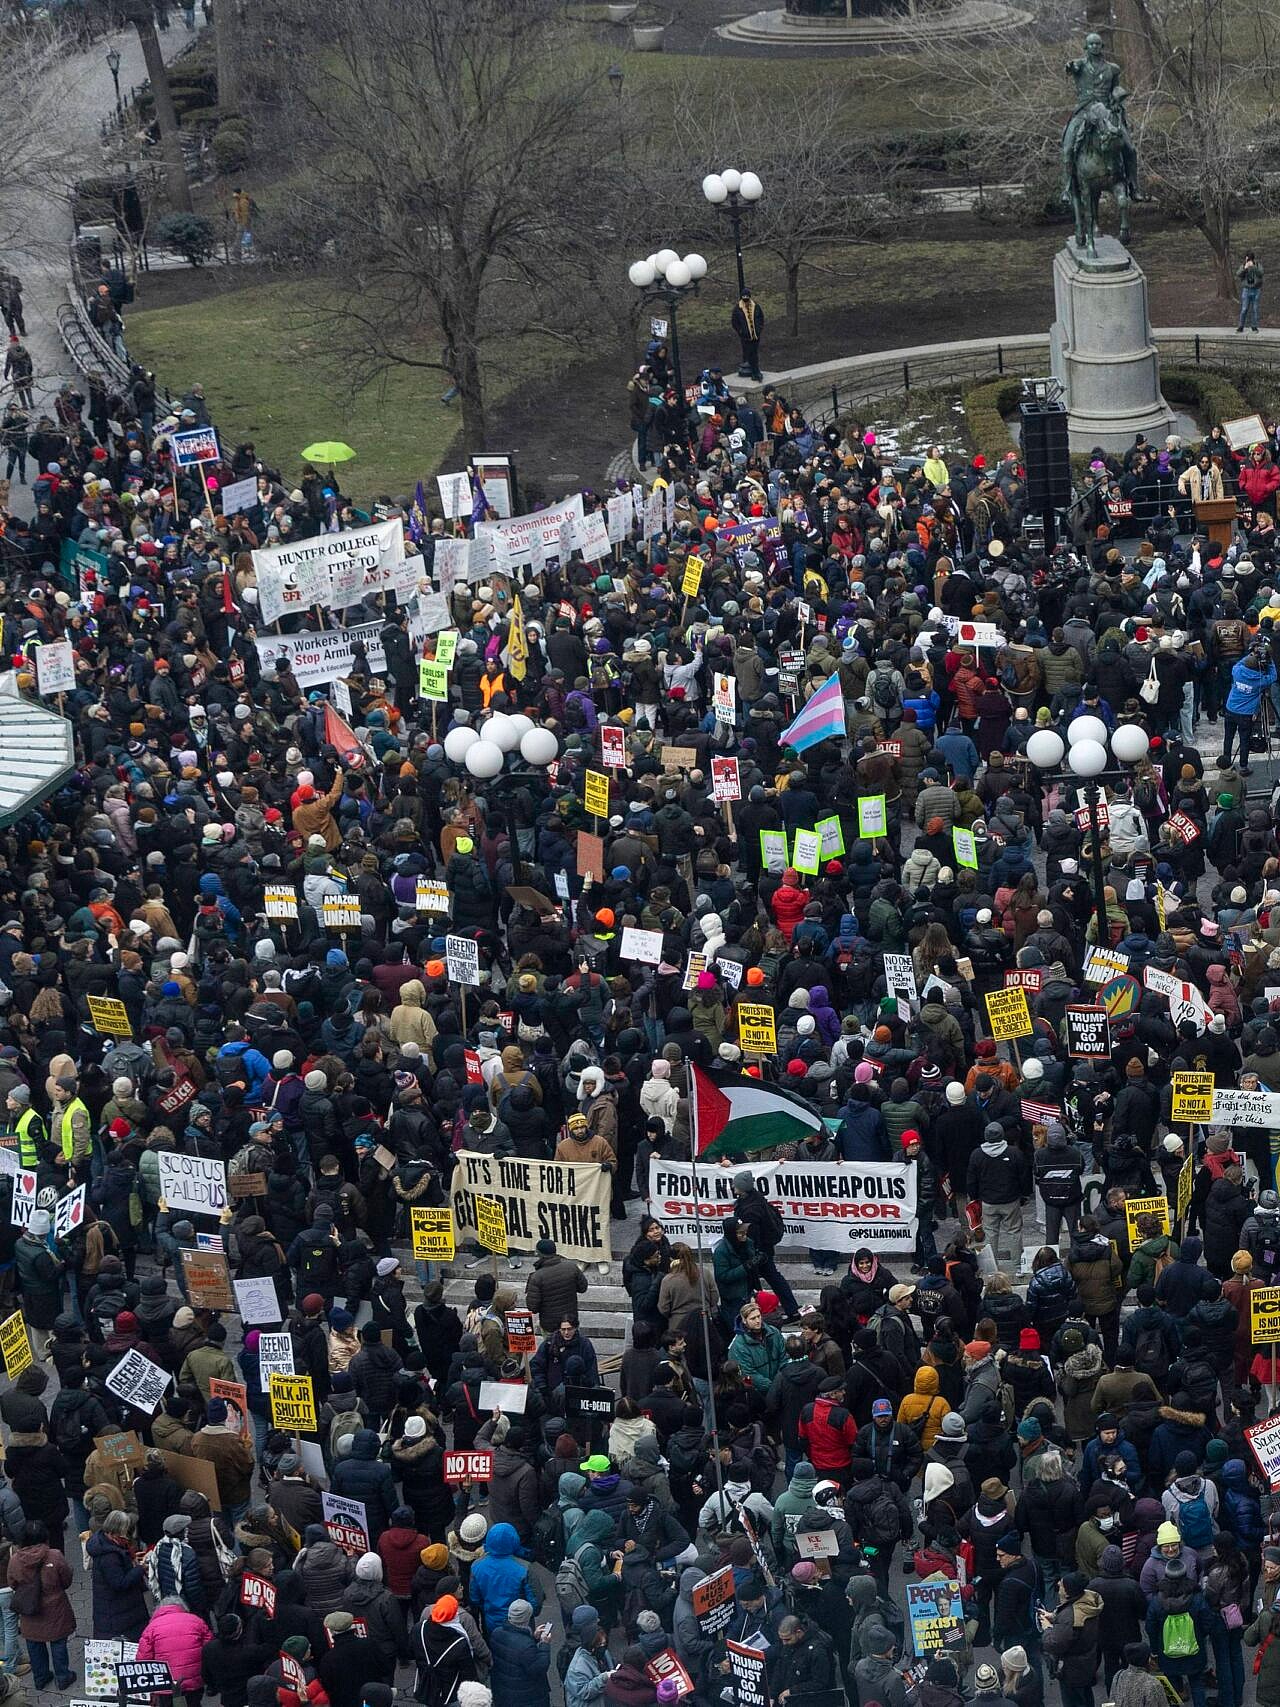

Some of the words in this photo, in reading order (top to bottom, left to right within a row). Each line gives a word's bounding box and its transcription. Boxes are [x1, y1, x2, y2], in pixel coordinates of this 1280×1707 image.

[510, 514, 562, 534] Committee
[564, 511, 576, 521] to
[278, 547, 326, 566] HUNTER
[328, 534, 379, 554] COLLEGE
[358, 555, 375, 567] TO
[977, 632, 994, 640] ICE
[294, 636, 338, 652] Workers
[295, 654, 320, 668] Stop
[422, 668, 444, 679] ABOLISH
[426, 678, 438, 688] ICE!
[886, 744, 900, 754] ICE!
[716, 788, 738, 799] STRIKE
[1079, 810, 1091, 824] NO
[1171, 812, 1185, 828] NO
[1183, 820, 1199, 841] ICE!
[265, 886, 295, 897] AMAZON
[417, 880, 447, 892] AMAZON
[324, 895, 360, 906] AMAZON
[416, 894, 449, 912] UNFAIR
[266, 902, 298, 918] UNFAIR
[325, 910, 362, 926] UNFAIR
[448, 937, 476, 954] DEFEND
[885, 956, 898, 965] NO
[1093, 948, 1129, 966] AMAZON
[1006, 972, 1020, 986] NO
[1021, 972, 1040, 986] ICE!
[987, 988, 1021, 1000] FIGHT
[90, 998, 107, 1007] DROP
[107, 1000, 123, 1010] THE
[740, 1004, 774, 1017] PROTESTING
[1178, 1002, 1196, 1018] NO
[990, 1006, 1001, 1016] AND
[1012, 1012, 1028, 1022] EVILS
[741, 1016, 772, 1028] ICE
[1068, 1012, 1106, 1024] TRUMP
[995, 1026, 1003, 1035] OF
[1072, 1022, 1104, 1032] MUST
[746, 1030, 752, 1039] IS
[752, 1030, 765, 1040] NOT
[764, 1030, 770, 1040] A
[1080, 1032, 1096, 1042] GO
[742, 1038, 775, 1047] CRIME!
[1076, 1042, 1105, 1052] NOW!
[1175, 1073, 1213, 1085] PROTESTING
[160, 1094, 178, 1111] NO
[174, 1080, 193, 1102] ICE!
[1175, 1084, 1211, 1098] ICE
[1215, 1091, 1236, 1100] Dad
[1238, 1092, 1250, 1100] did
[1252, 1094, 1266, 1104] not
[1179, 1100, 1187, 1111] IS
[1188, 1100, 1200, 1111] NOT
[1199, 1100, 1206, 1111] A
[1245, 1114, 1264, 1124] this
[466, 1158, 492, 1185] IT'S
[498, 1160, 531, 1192] TIME
[540, 1165, 564, 1195] FOR
[568, 1168, 577, 1196] A
[16, 1174, 22, 1195] I
[656, 1172, 710, 1199] FROM
[775, 1174, 906, 1200] MINNEAPOLIS
[164, 1178, 210, 1203] FAILED
[208, 1183, 227, 1209] US
[664, 1201, 736, 1218] STOP
[787, 1201, 901, 1220] TERROR
[1127, 1199, 1166, 1211] PROTESTING
[14, 1202, 34, 1225] NY
[414, 1208, 450, 1220] PROTESTING
[414, 1220, 450, 1232] ICE
[538, 1200, 602, 1248] STRIKE
[848, 1227, 912, 1240] @PSLNATIONAL
[420, 1236, 428, 1247] IS
[429, 1236, 441, 1248] NOT
[442, 1237, 448, 1248] A
[416, 1246, 452, 1255] CRIME!
[1259, 1318, 1267, 1328] IS
[260, 1336, 290, 1352] DEFEND
[109, 1352, 143, 1391] DEFEND
[273, 1376, 307, 1384] HONOR
[273, 1385, 294, 1402] MLK
[296, 1386, 309, 1402] JR
[276, 1404, 301, 1419] SHUT
[302, 1404, 311, 1420] IT
[580, 1399, 611, 1413] ICE=DEATH
[276, 1415, 313, 1424] DOWN!
[446, 1455, 465, 1474] NO
[468, 1455, 490, 1473] ICE!
[328, 1496, 360, 1512] IMMIGRANTS
[328, 1526, 344, 1542] NO
[345, 1530, 366, 1549] ICE!
[244, 1578, 262, 1596] NO
[914, 1616, 958, 1631] SEXIST
[916, 1630, 940, 1641] MAN
[917, 1639, 944, 1650] ALIVE
[282, 1656, 296, 1677] NO
[652, 1652, 676, 1674] NO
[729, 1651, 764, 1672] TRUMP
[119, 1662, 168, 1678] ABOLISH
[733, 1664, 761, 1682] MUST
[126, 1674, 170, 1690] I.C.E.
[740, 1680, 756, 1692] GO
[738, 1688, 765, 1706] NOW!
